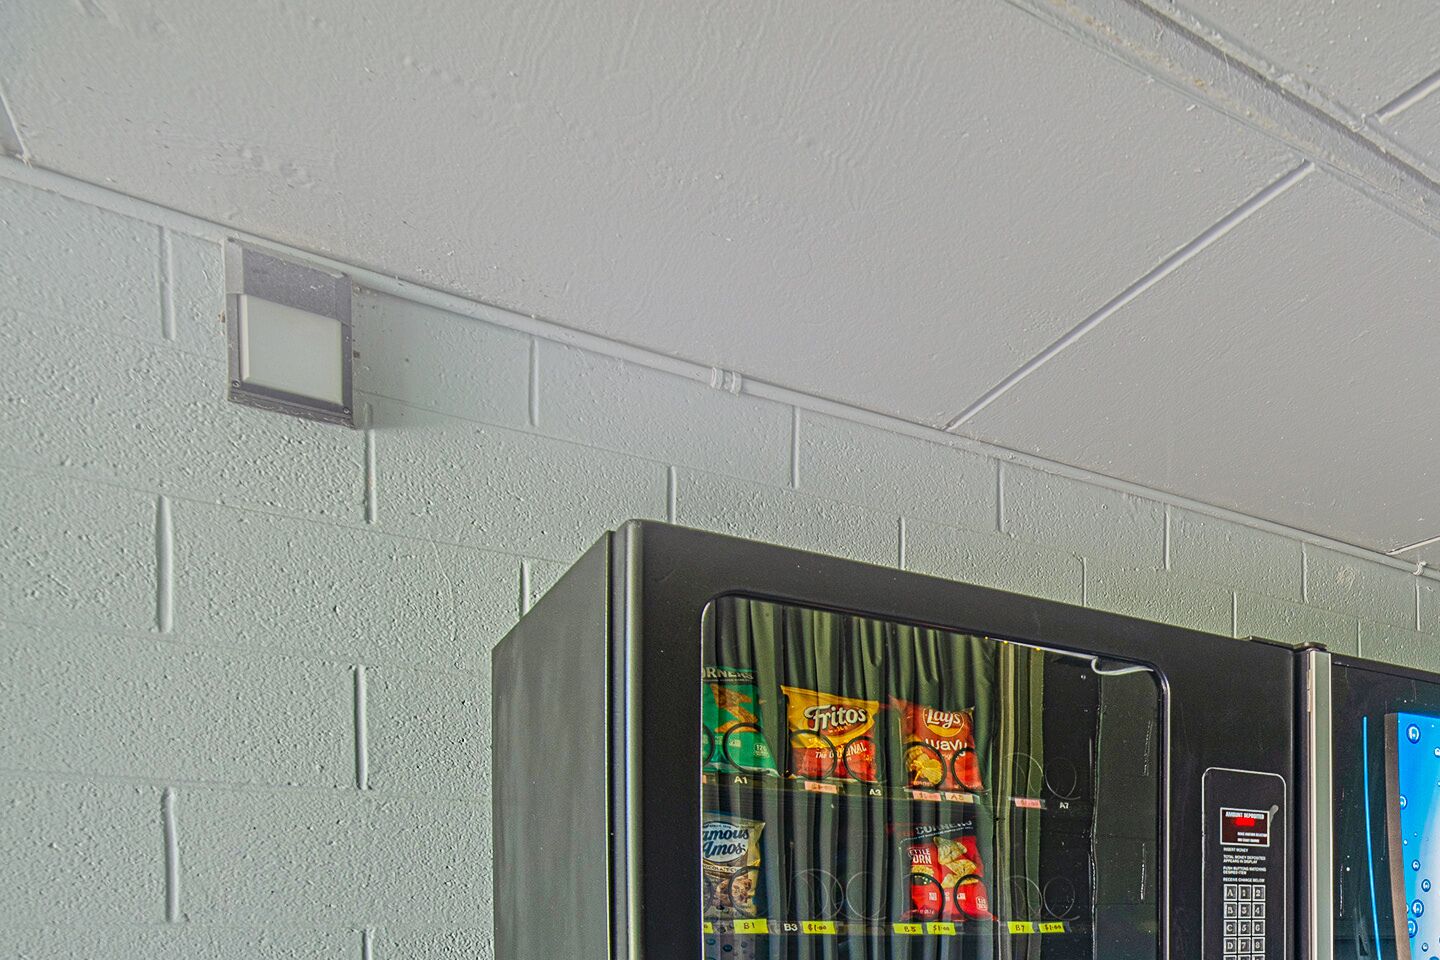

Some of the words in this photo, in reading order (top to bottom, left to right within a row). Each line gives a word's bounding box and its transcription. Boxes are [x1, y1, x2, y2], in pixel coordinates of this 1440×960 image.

[803, 703, 867, 732] Fritos
[734, 776, 748, 784] A1
[1059, 801, 1070, 809] A7
[784, 922, 798, 931] B3
